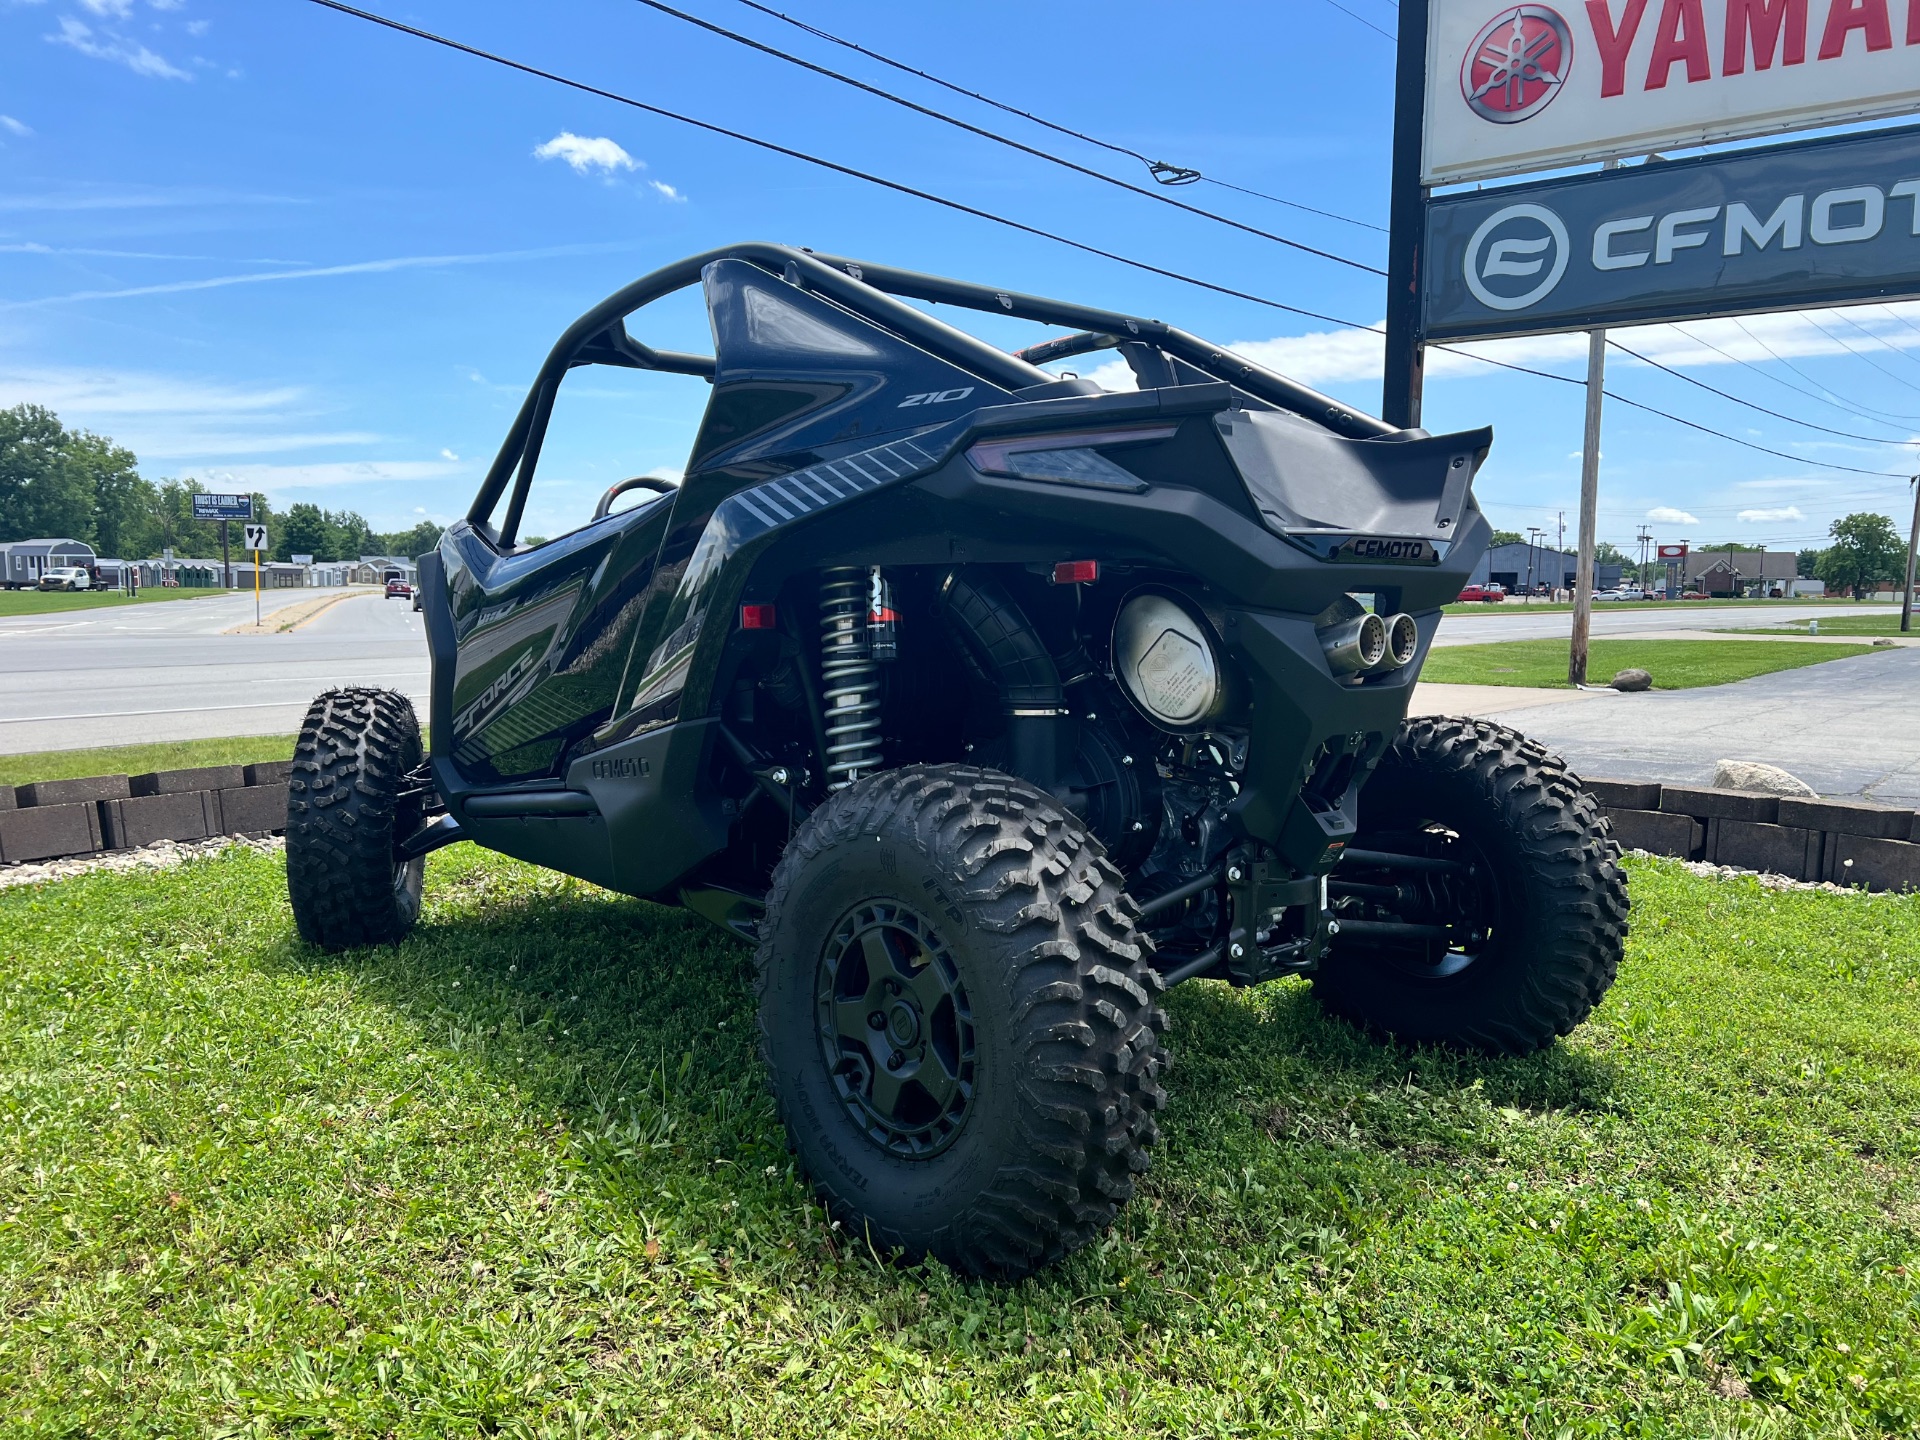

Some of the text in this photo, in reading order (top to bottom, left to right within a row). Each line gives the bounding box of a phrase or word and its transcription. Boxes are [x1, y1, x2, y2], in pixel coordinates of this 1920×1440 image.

[1585, 0, 1920, 98] YAMA
[898, 387, 974, 408] Z10
[194, 495, 211, 505] TRUST
[212, 495, 218, 505] IS
[1354, 540, 1422, 559] CFMOTO
[453, 646, 533, 736] ZFORCE
[592, 757, 650, 779] CFMOTO
[819, 1134, 869, 1191] TERRA
